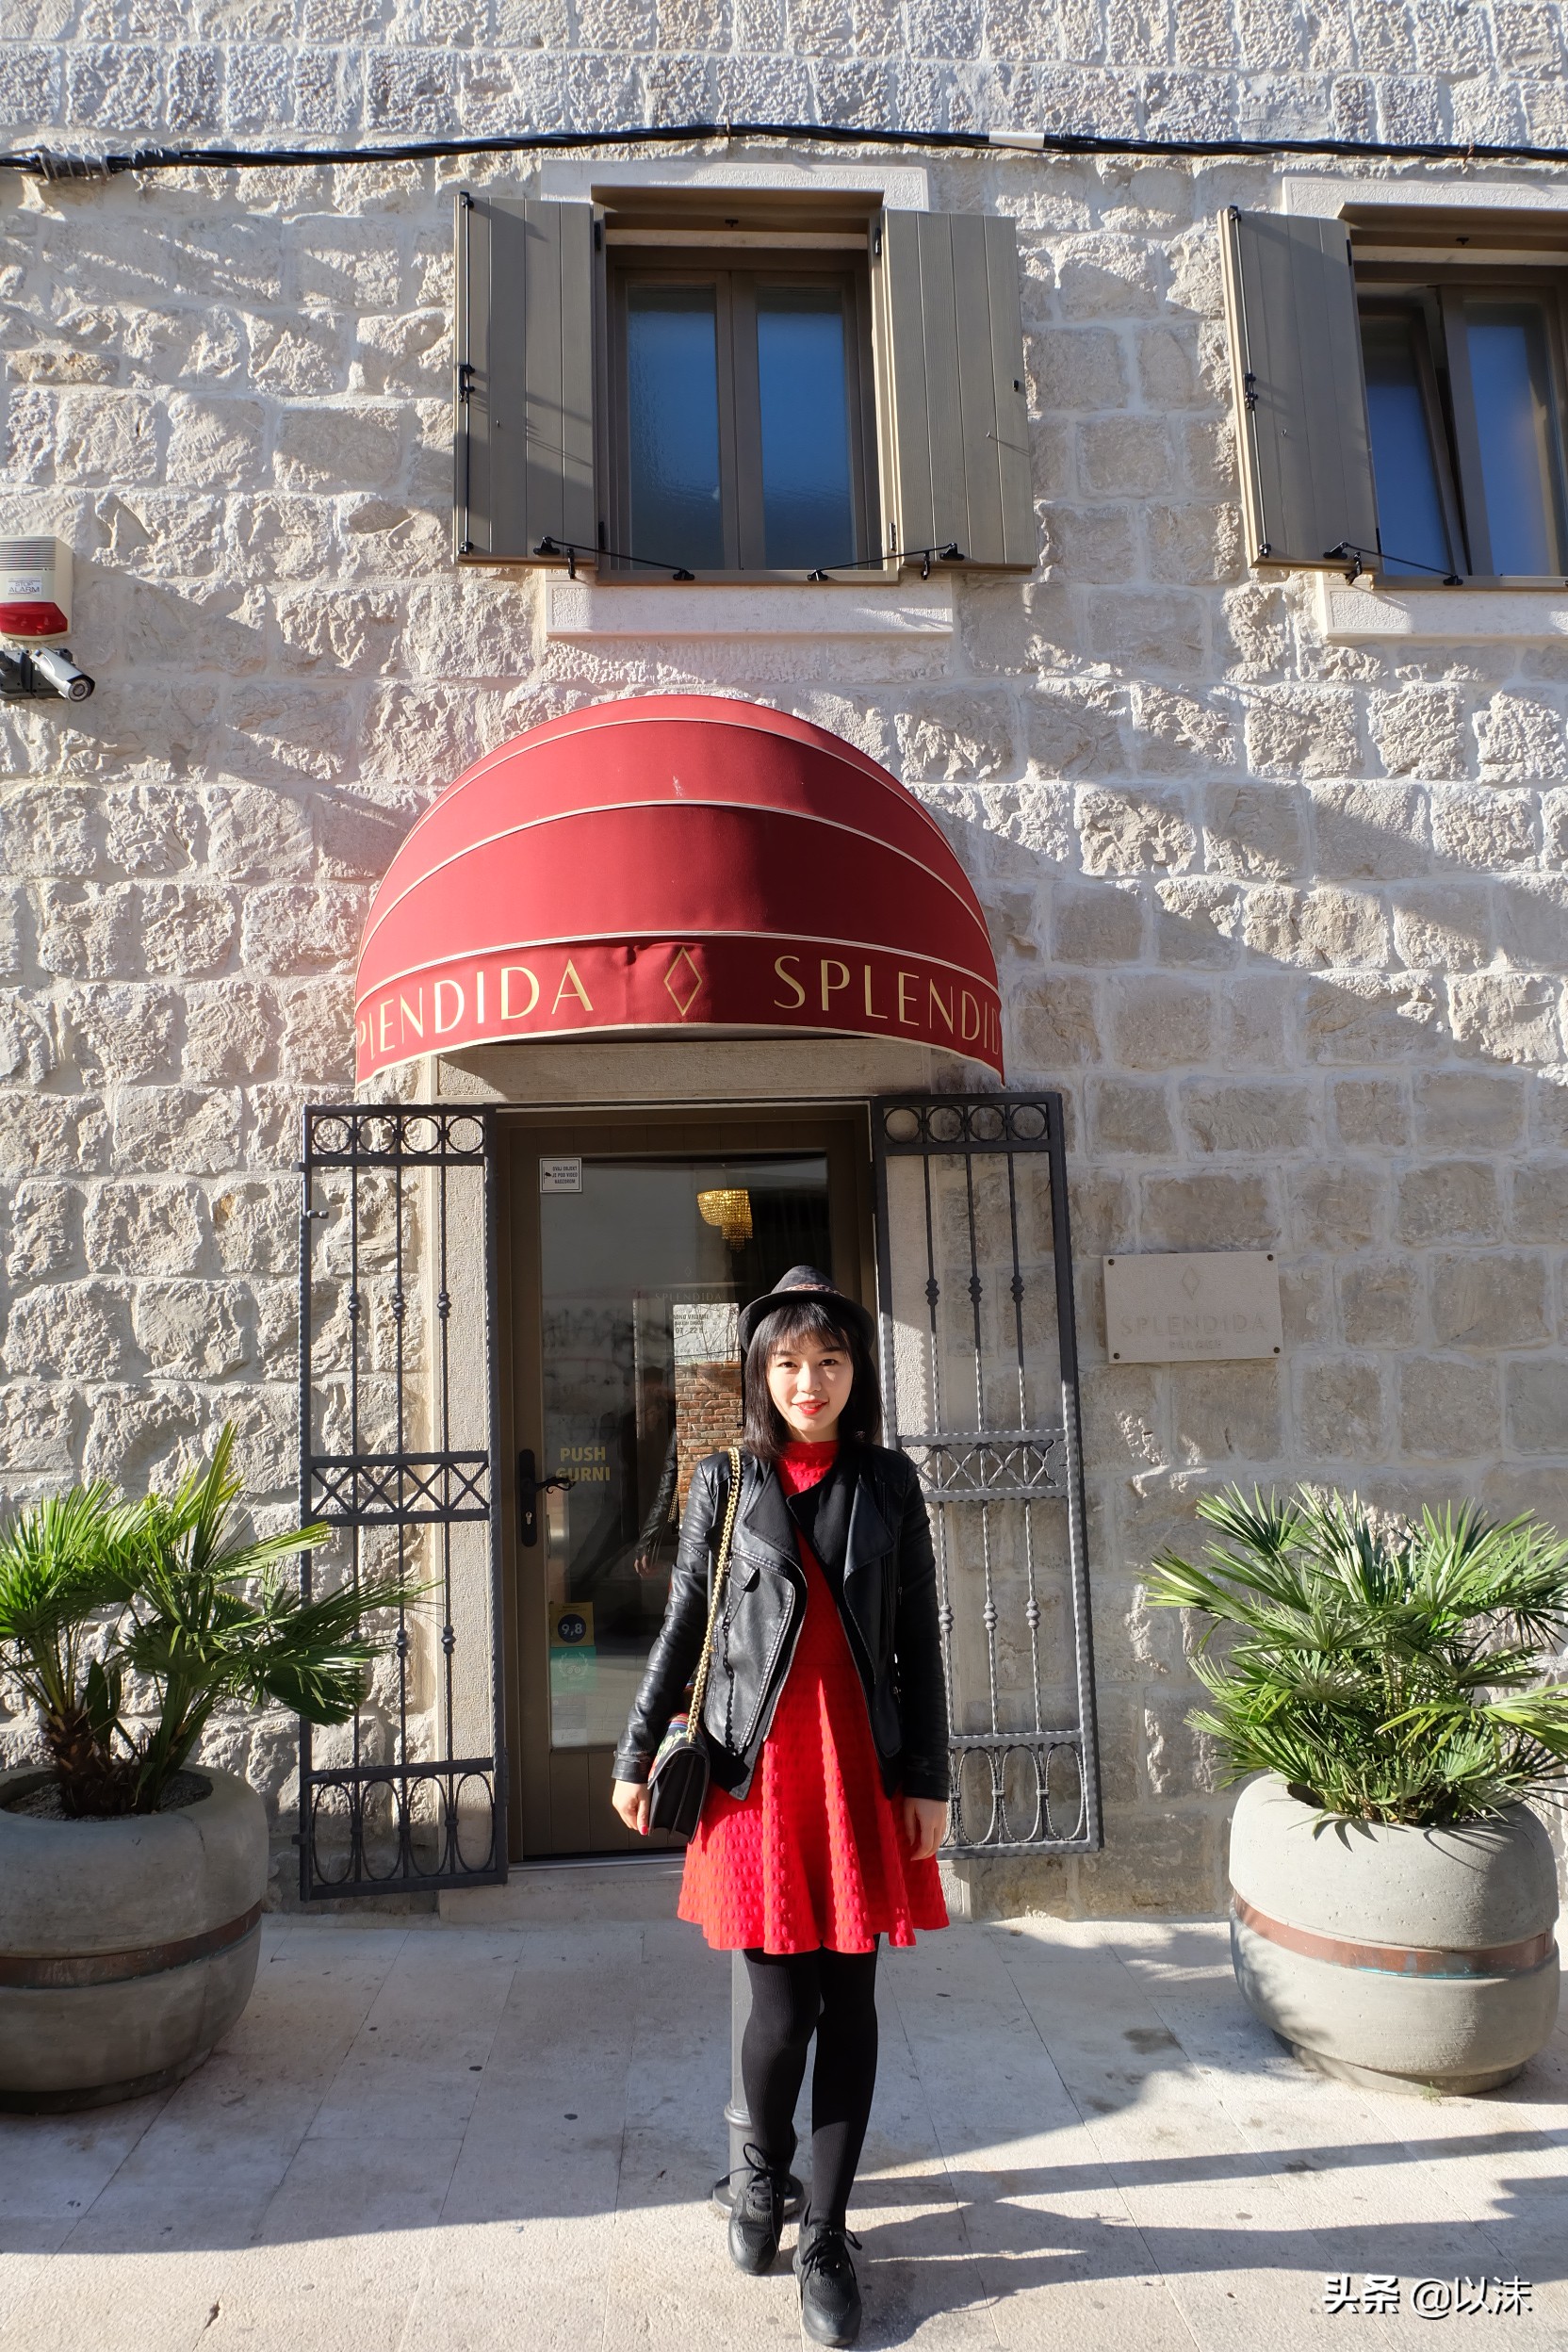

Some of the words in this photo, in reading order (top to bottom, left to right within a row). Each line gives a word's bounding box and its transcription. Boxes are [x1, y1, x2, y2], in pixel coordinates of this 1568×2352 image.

[655, 1292, 722, 1302] SPLENDIDA
[1120, 1312, 1267, 1336] SPLENDIDA
[1169, 1339, 1223, 1350] PALACE
[560, 1446, 606, 1462] PUSH
[555, 1466, 611, 1482] GURNI
[561, 1623, 582, 1636] 9,8
